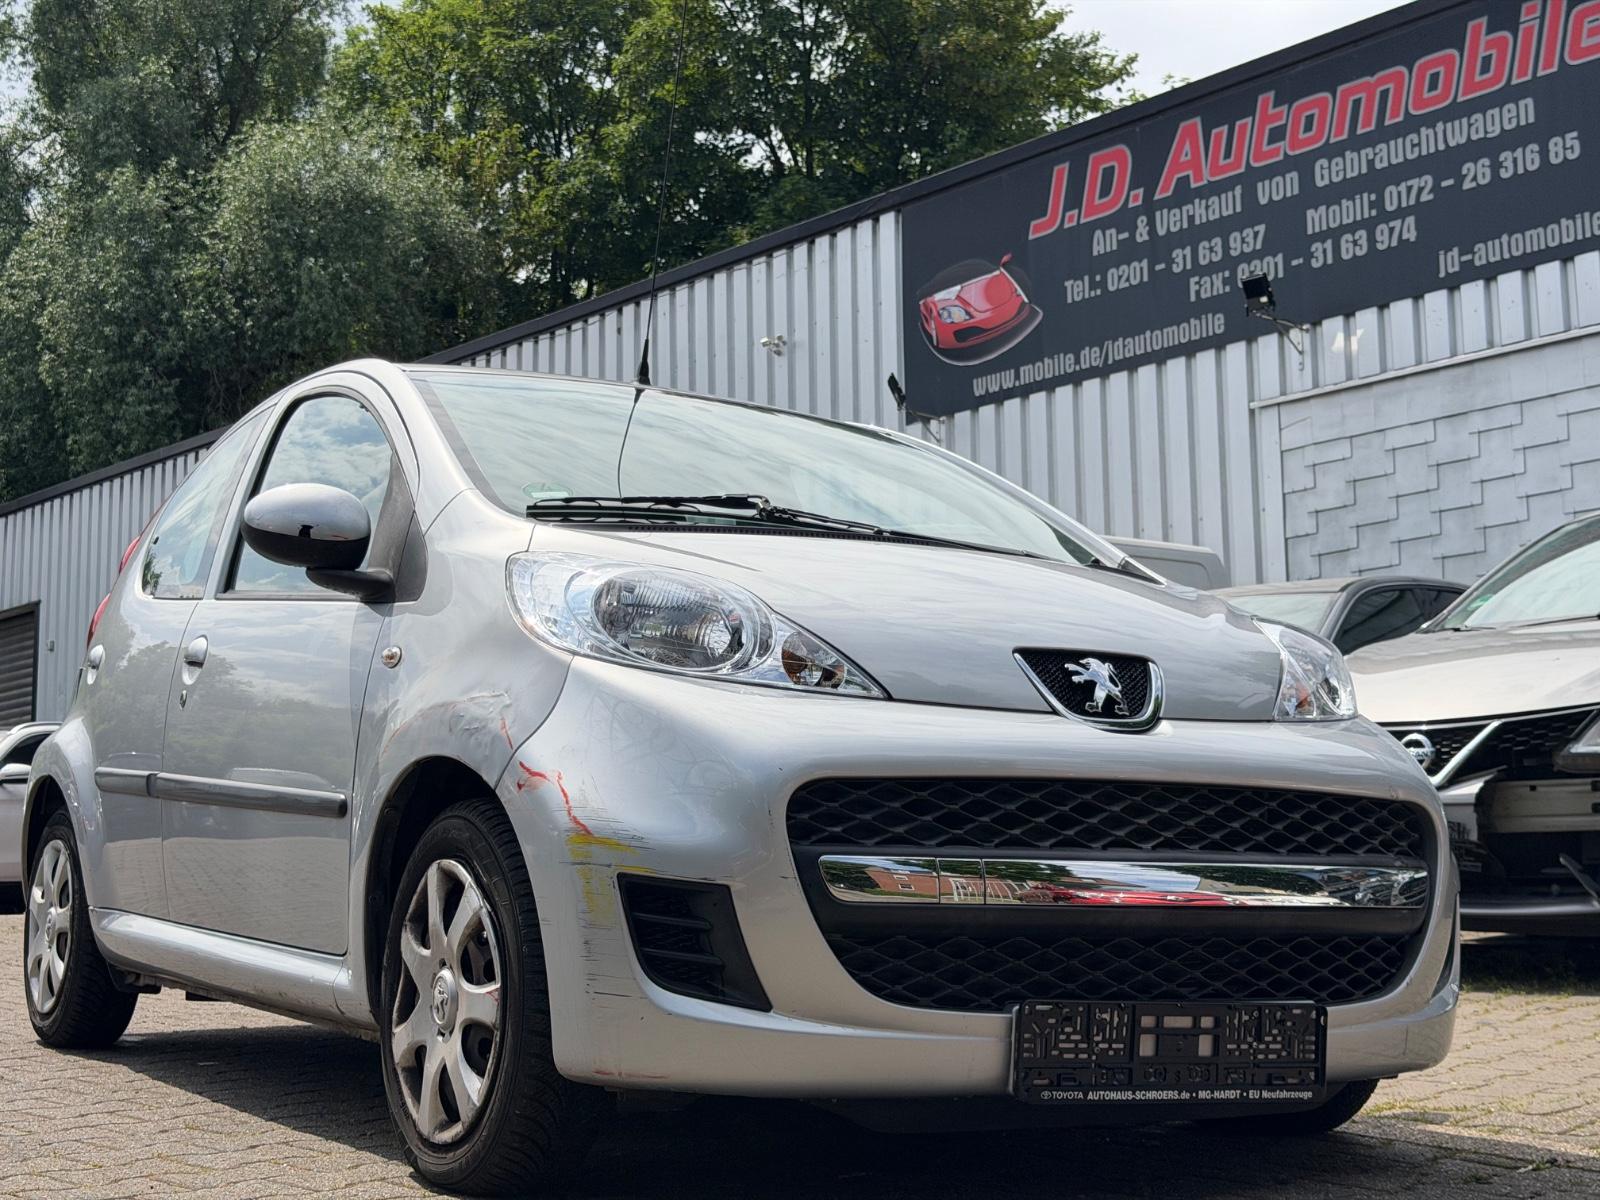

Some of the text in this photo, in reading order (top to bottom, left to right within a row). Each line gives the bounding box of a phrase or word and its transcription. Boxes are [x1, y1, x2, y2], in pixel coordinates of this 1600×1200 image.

[1028, 0, 1600, 240] J.D. Automobile
[1092, 97, 1535, 256] An- & Verkauf von Gebrauchtwagen
[1306, 193, 1376, 235] Mobil:
[1384, 174, 1434, 212] 0172
[1461, 157, 1492, 190] 26
[1499, 143, 1540, 179] 316
[1548, 131, 1581, 165] 85
[1064, 274, 1101, 304] Tel.:
[1106, 258, 1149, 292] 0201
[1171, 245, 1192, 273] 31
[1198, 236, 1222, 265] 63
[1229, 223, 1266, 257] 937
[1189, 270, 1230, 302] Fax:
[1310, 238, 1333, 269] 31
[1340, 229, 1368, 260] 63
[1375, 215, 1417, 251] 974
[973, 312, 1225, 397] www.mobile.de/jdautomobile
[1051, 1091, 1084, 1100] TOYOTA
[1086, 1090, 1190, 1100] AUTOHAUS-SCHROERS.de
[1248, 1090, 1260, 1098] EU
[1261, 1090, 1313, 1100] Neufahrzeuge
